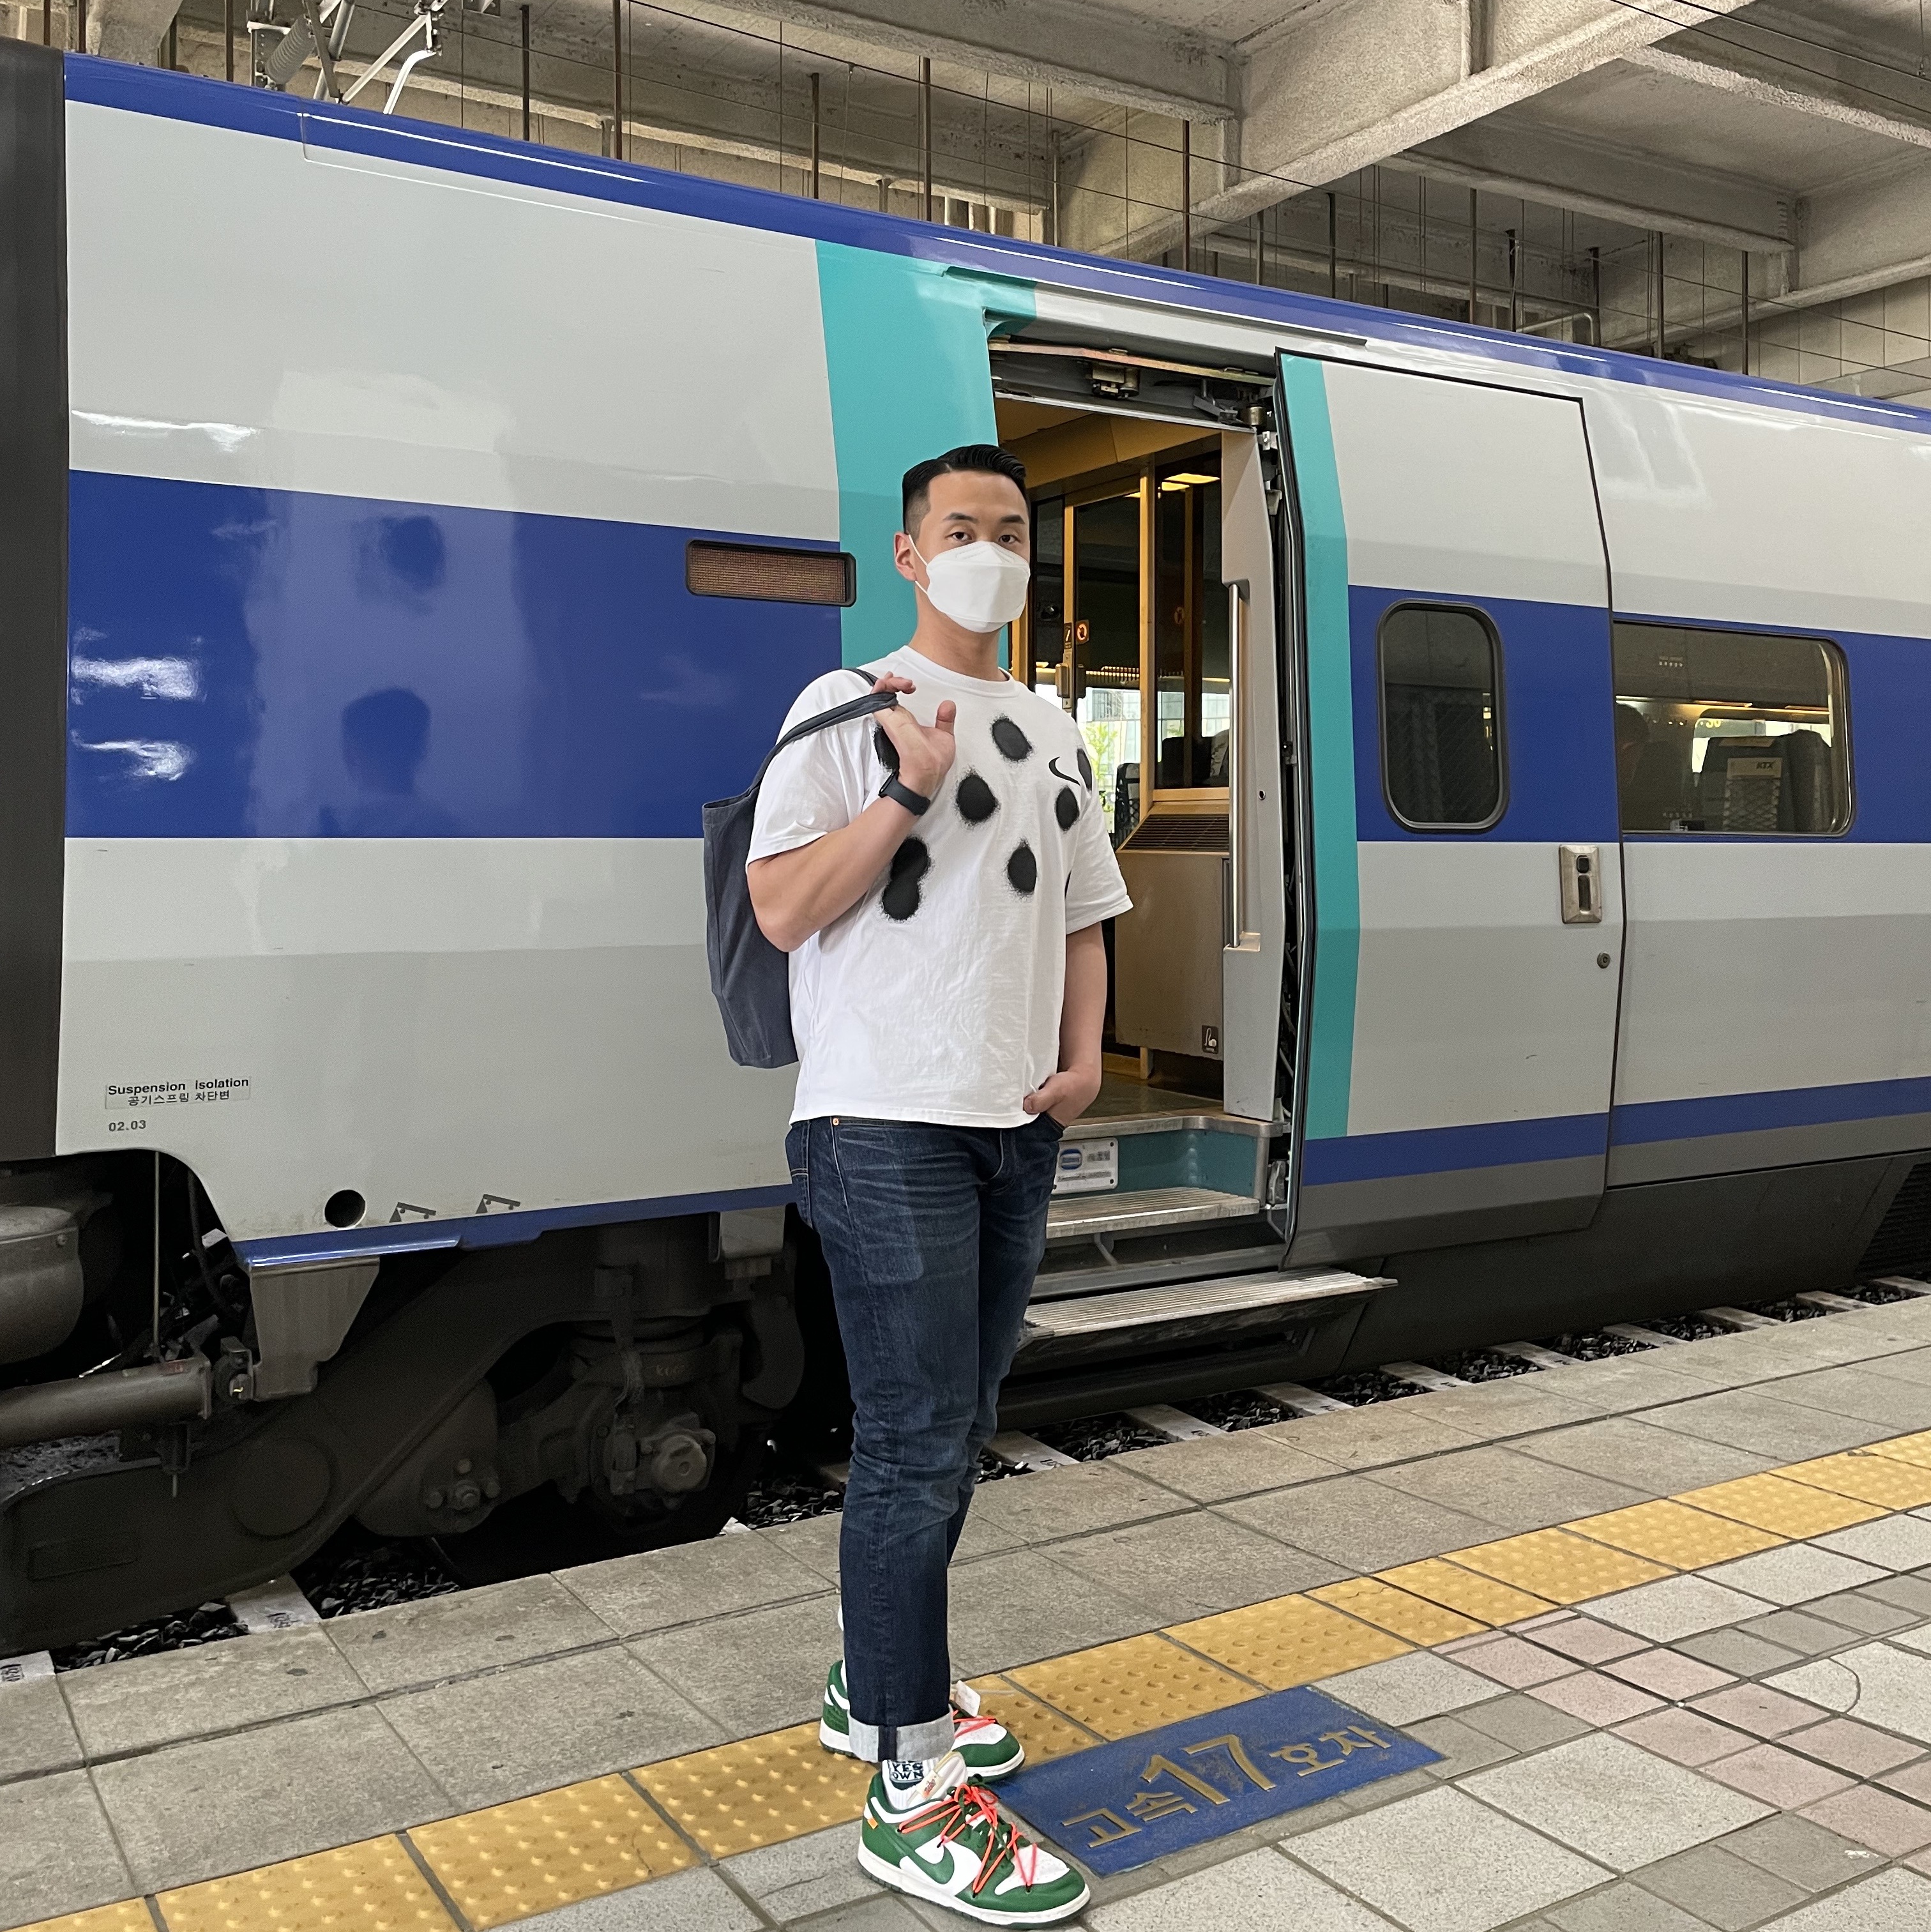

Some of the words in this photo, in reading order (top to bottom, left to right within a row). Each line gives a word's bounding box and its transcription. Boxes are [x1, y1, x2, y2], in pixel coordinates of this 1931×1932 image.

[109, 1081, 186, 1096] Suspension
[128, 1093, 189, 1106] 공기스프링
[109, 1120, 146, 1132] 02.03
[1061, 1791, 1199, 1848] 고속
